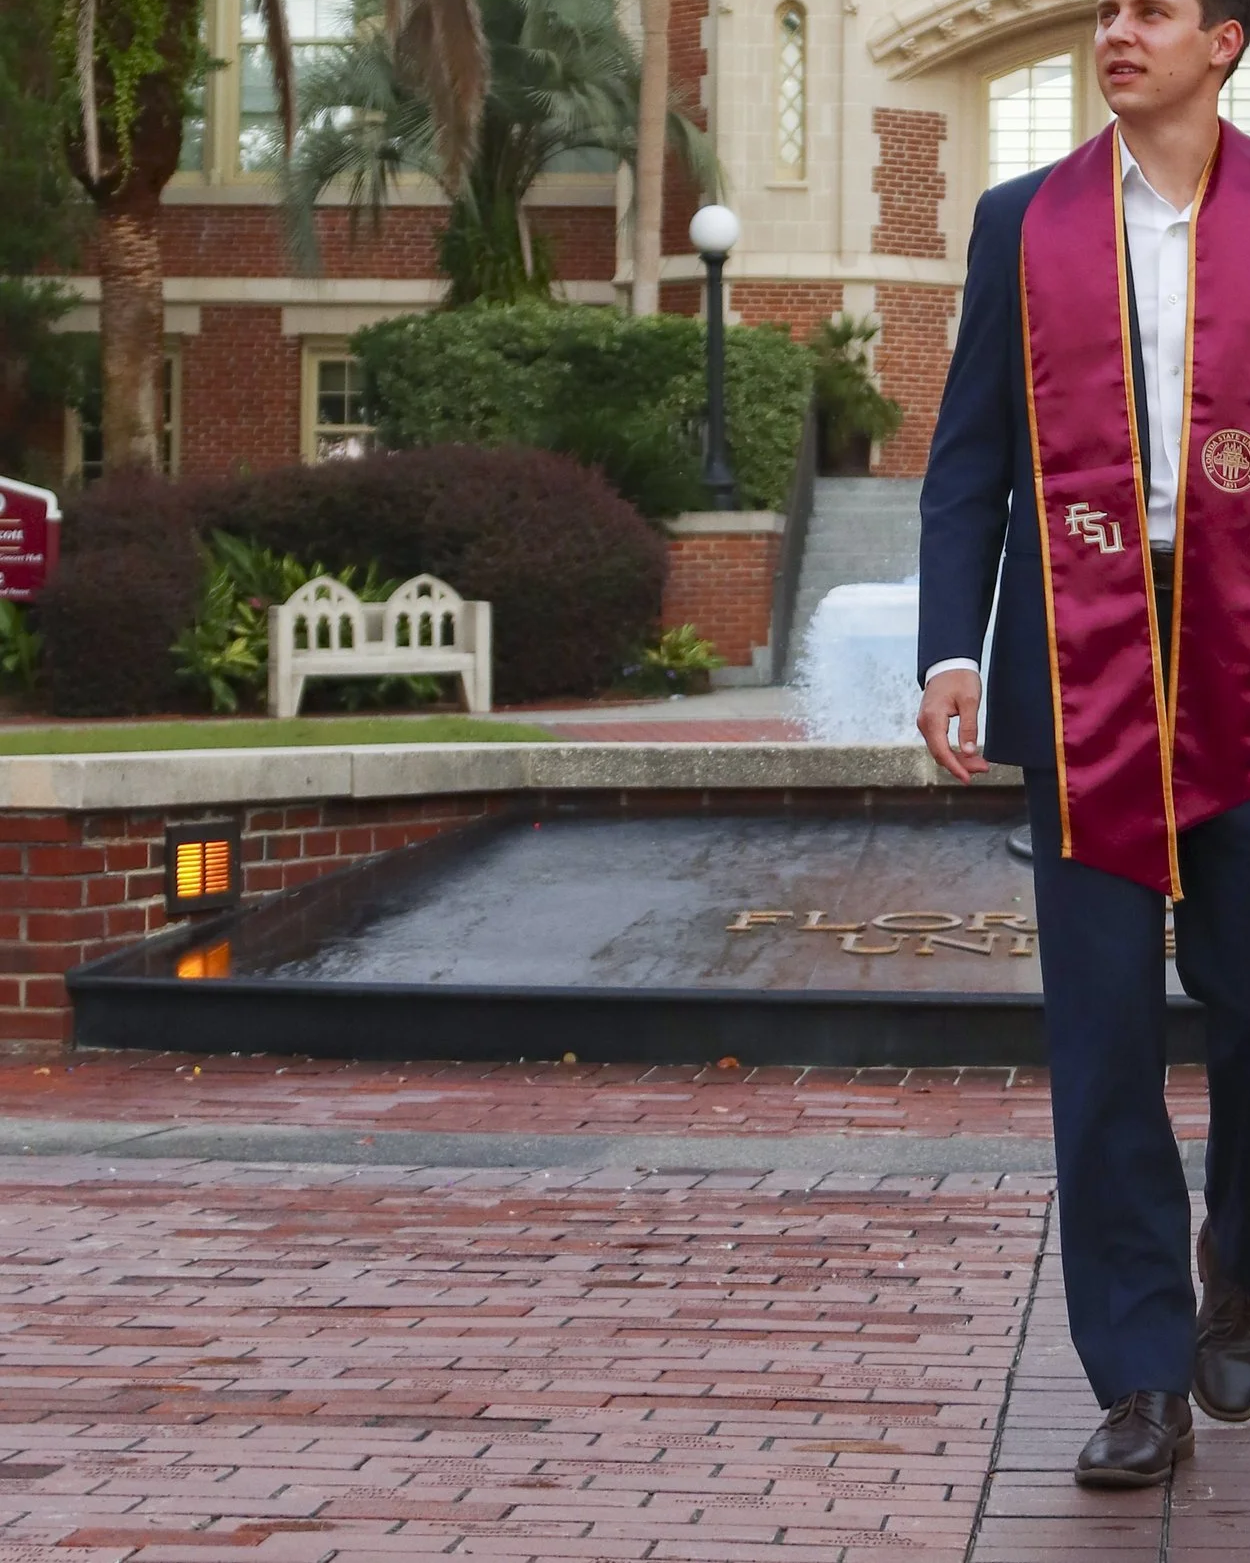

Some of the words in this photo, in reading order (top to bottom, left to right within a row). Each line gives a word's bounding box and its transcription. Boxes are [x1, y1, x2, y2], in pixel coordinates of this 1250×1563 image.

[1205, 440, 1219, 474] FLORIDA
[1218, 433, 1241, 441] STATE
[1064, 502, 1125, 554] FSU
